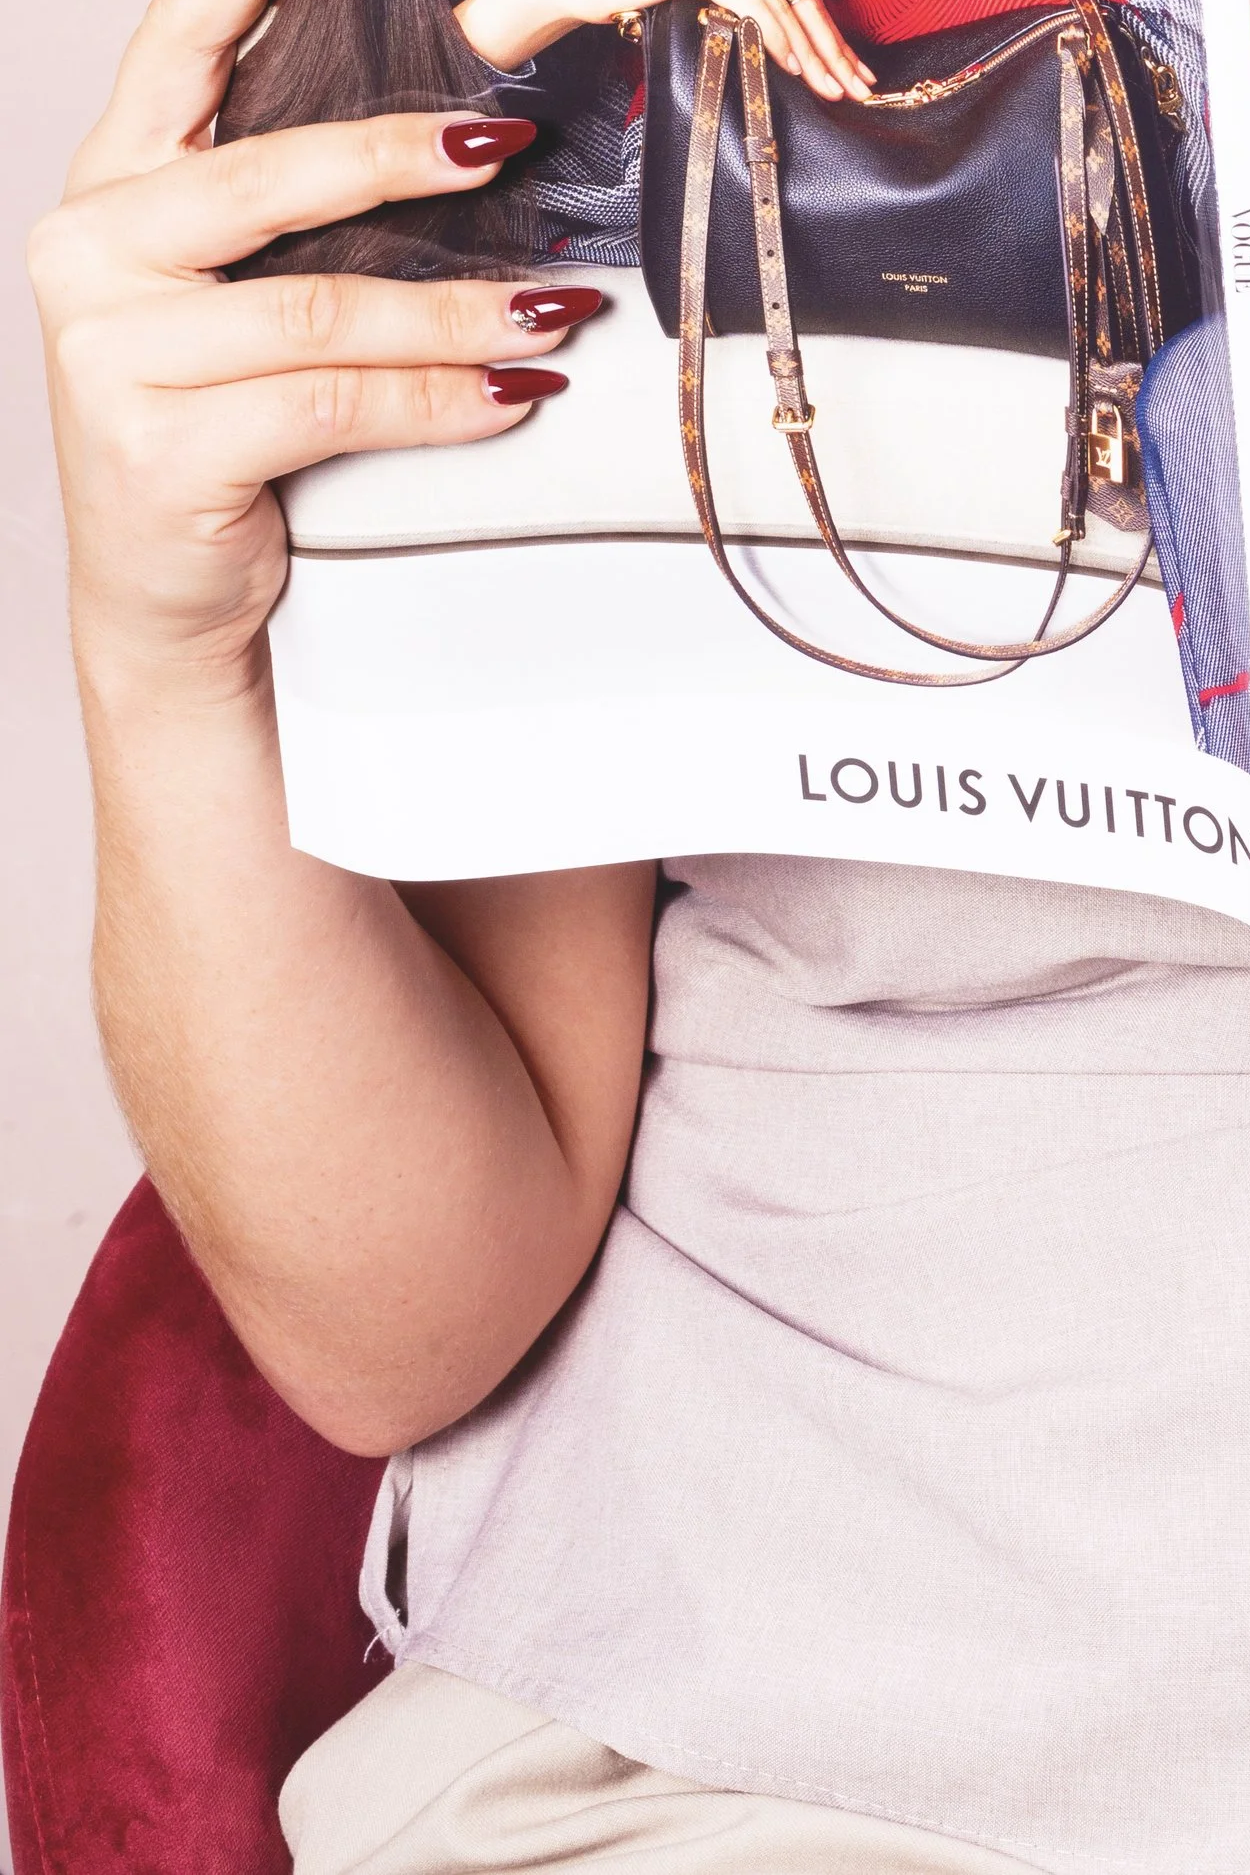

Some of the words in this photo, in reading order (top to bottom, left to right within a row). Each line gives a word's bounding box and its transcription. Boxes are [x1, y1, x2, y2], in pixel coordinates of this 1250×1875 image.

[881, 272, 908, 282] LOUIS
[909, 274, 948, 283] VUITTON
[904, 284, 929, 293] PARIS
[798, 754, 987, 816] LOUIS
